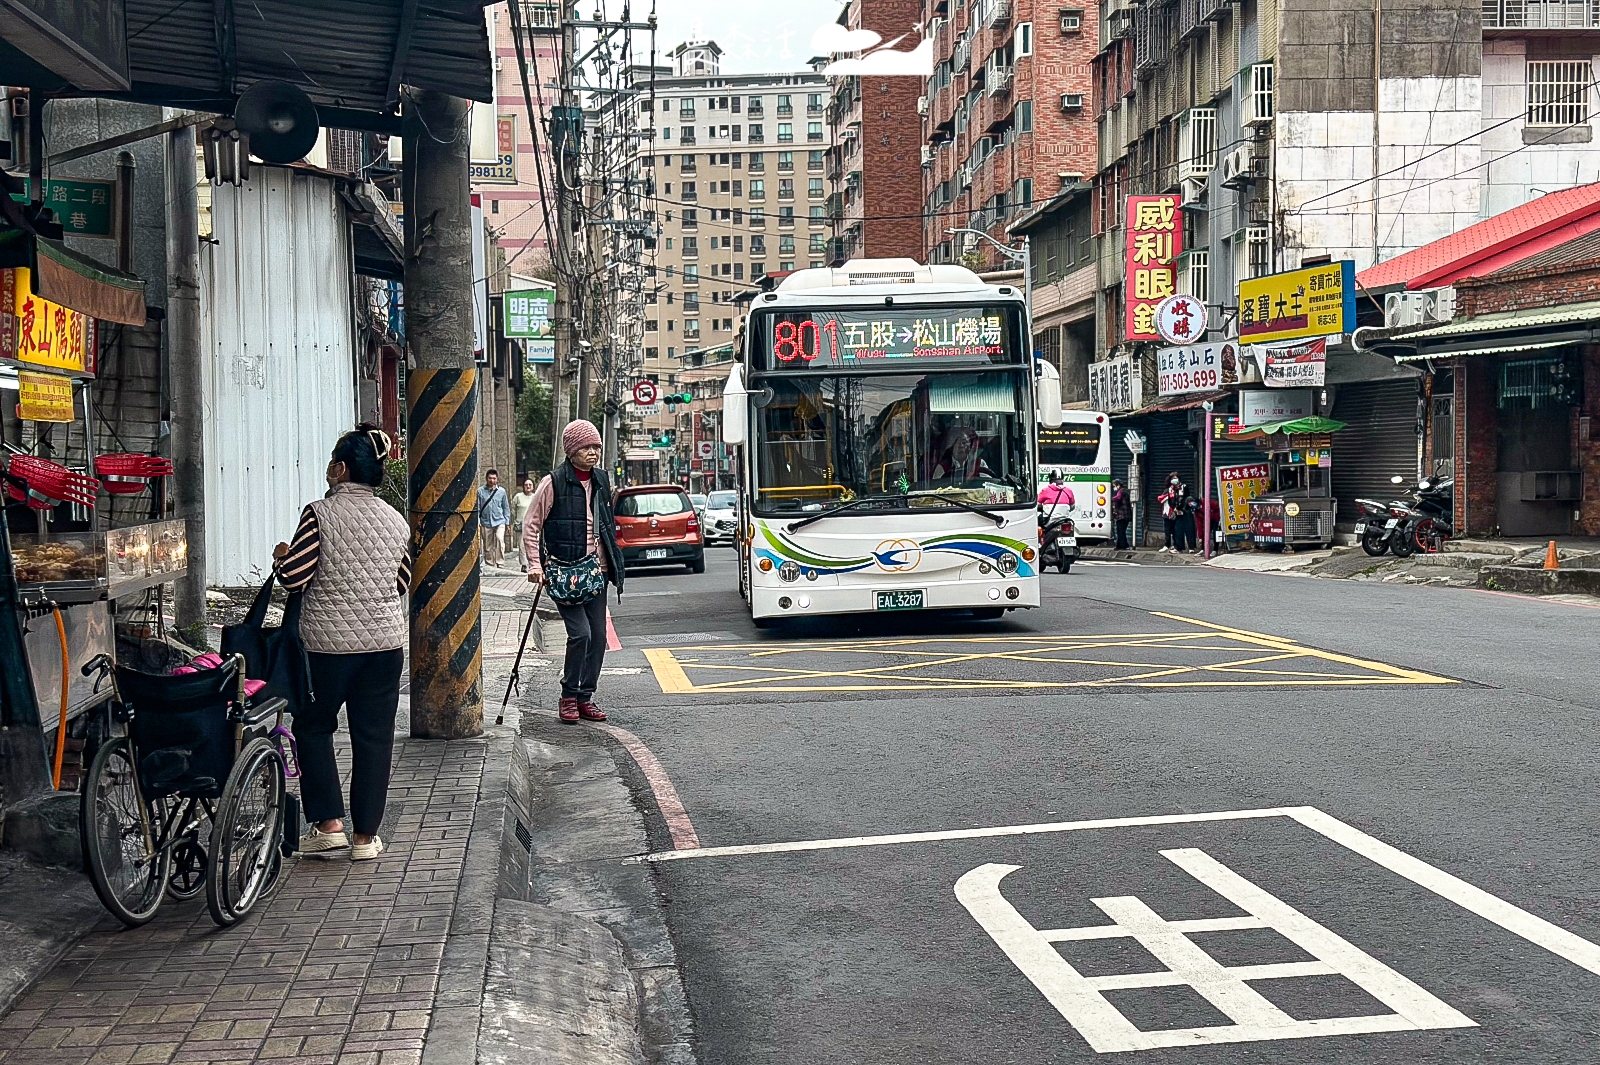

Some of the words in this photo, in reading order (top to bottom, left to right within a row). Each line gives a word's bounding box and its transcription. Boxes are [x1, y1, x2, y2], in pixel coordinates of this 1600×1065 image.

[509, 297, 549, 315] 明志
[19, 295, 84, 365] 東山鴨頭
[774, 319, 838, 363] 801
[842, 321, 897, 348] 五股
[912, 316, 1003, 347] 松山機場
[877, 594, 922, 608] EAL-3287
